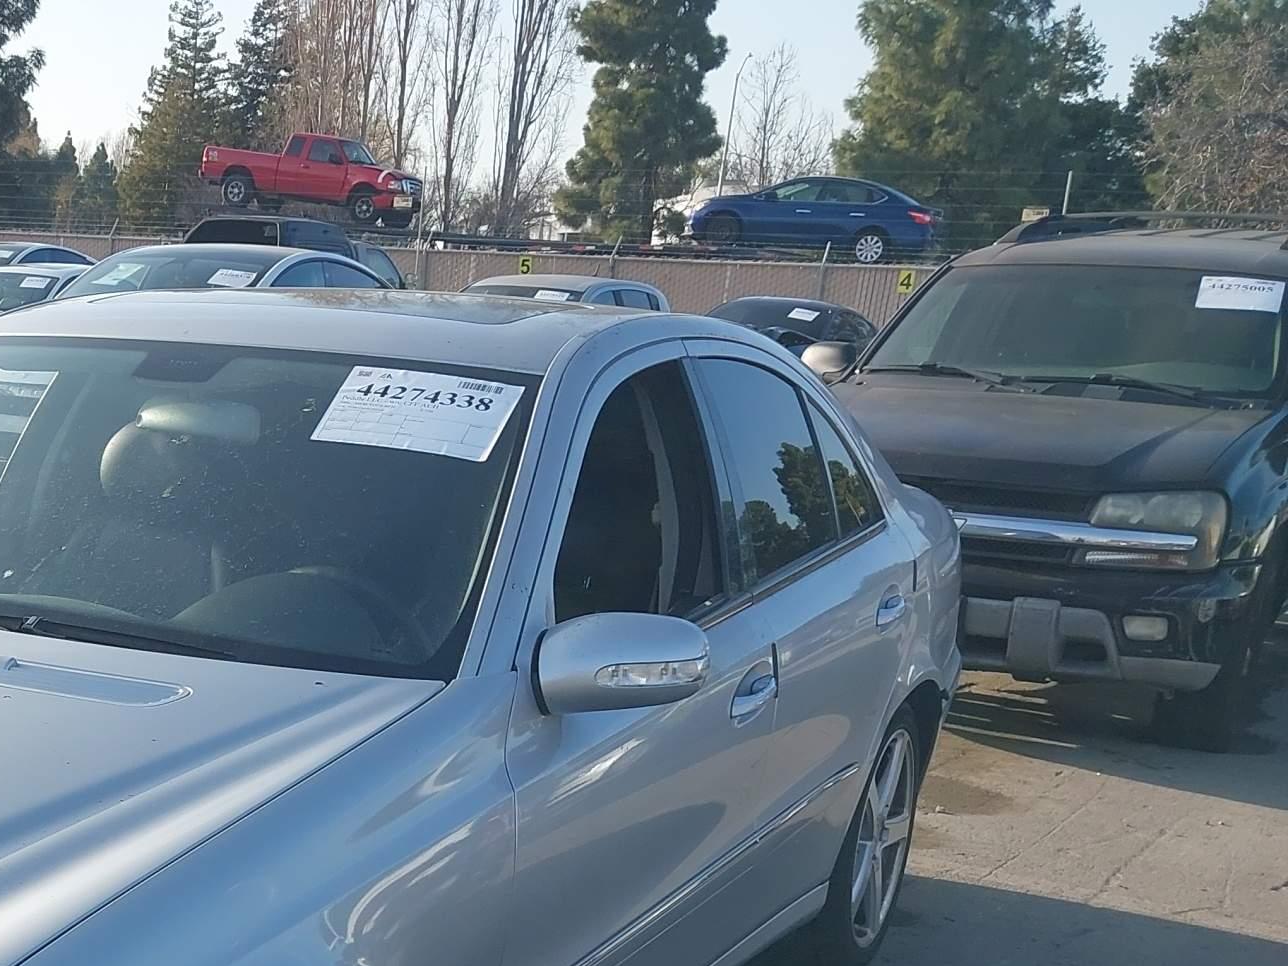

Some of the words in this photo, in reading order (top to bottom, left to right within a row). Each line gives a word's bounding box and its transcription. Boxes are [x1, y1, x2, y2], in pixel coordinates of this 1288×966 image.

[521, 259, 530, 274] 5
[900, 273, 912, 290] 4
[356, 383, 494, 412] 44274338
